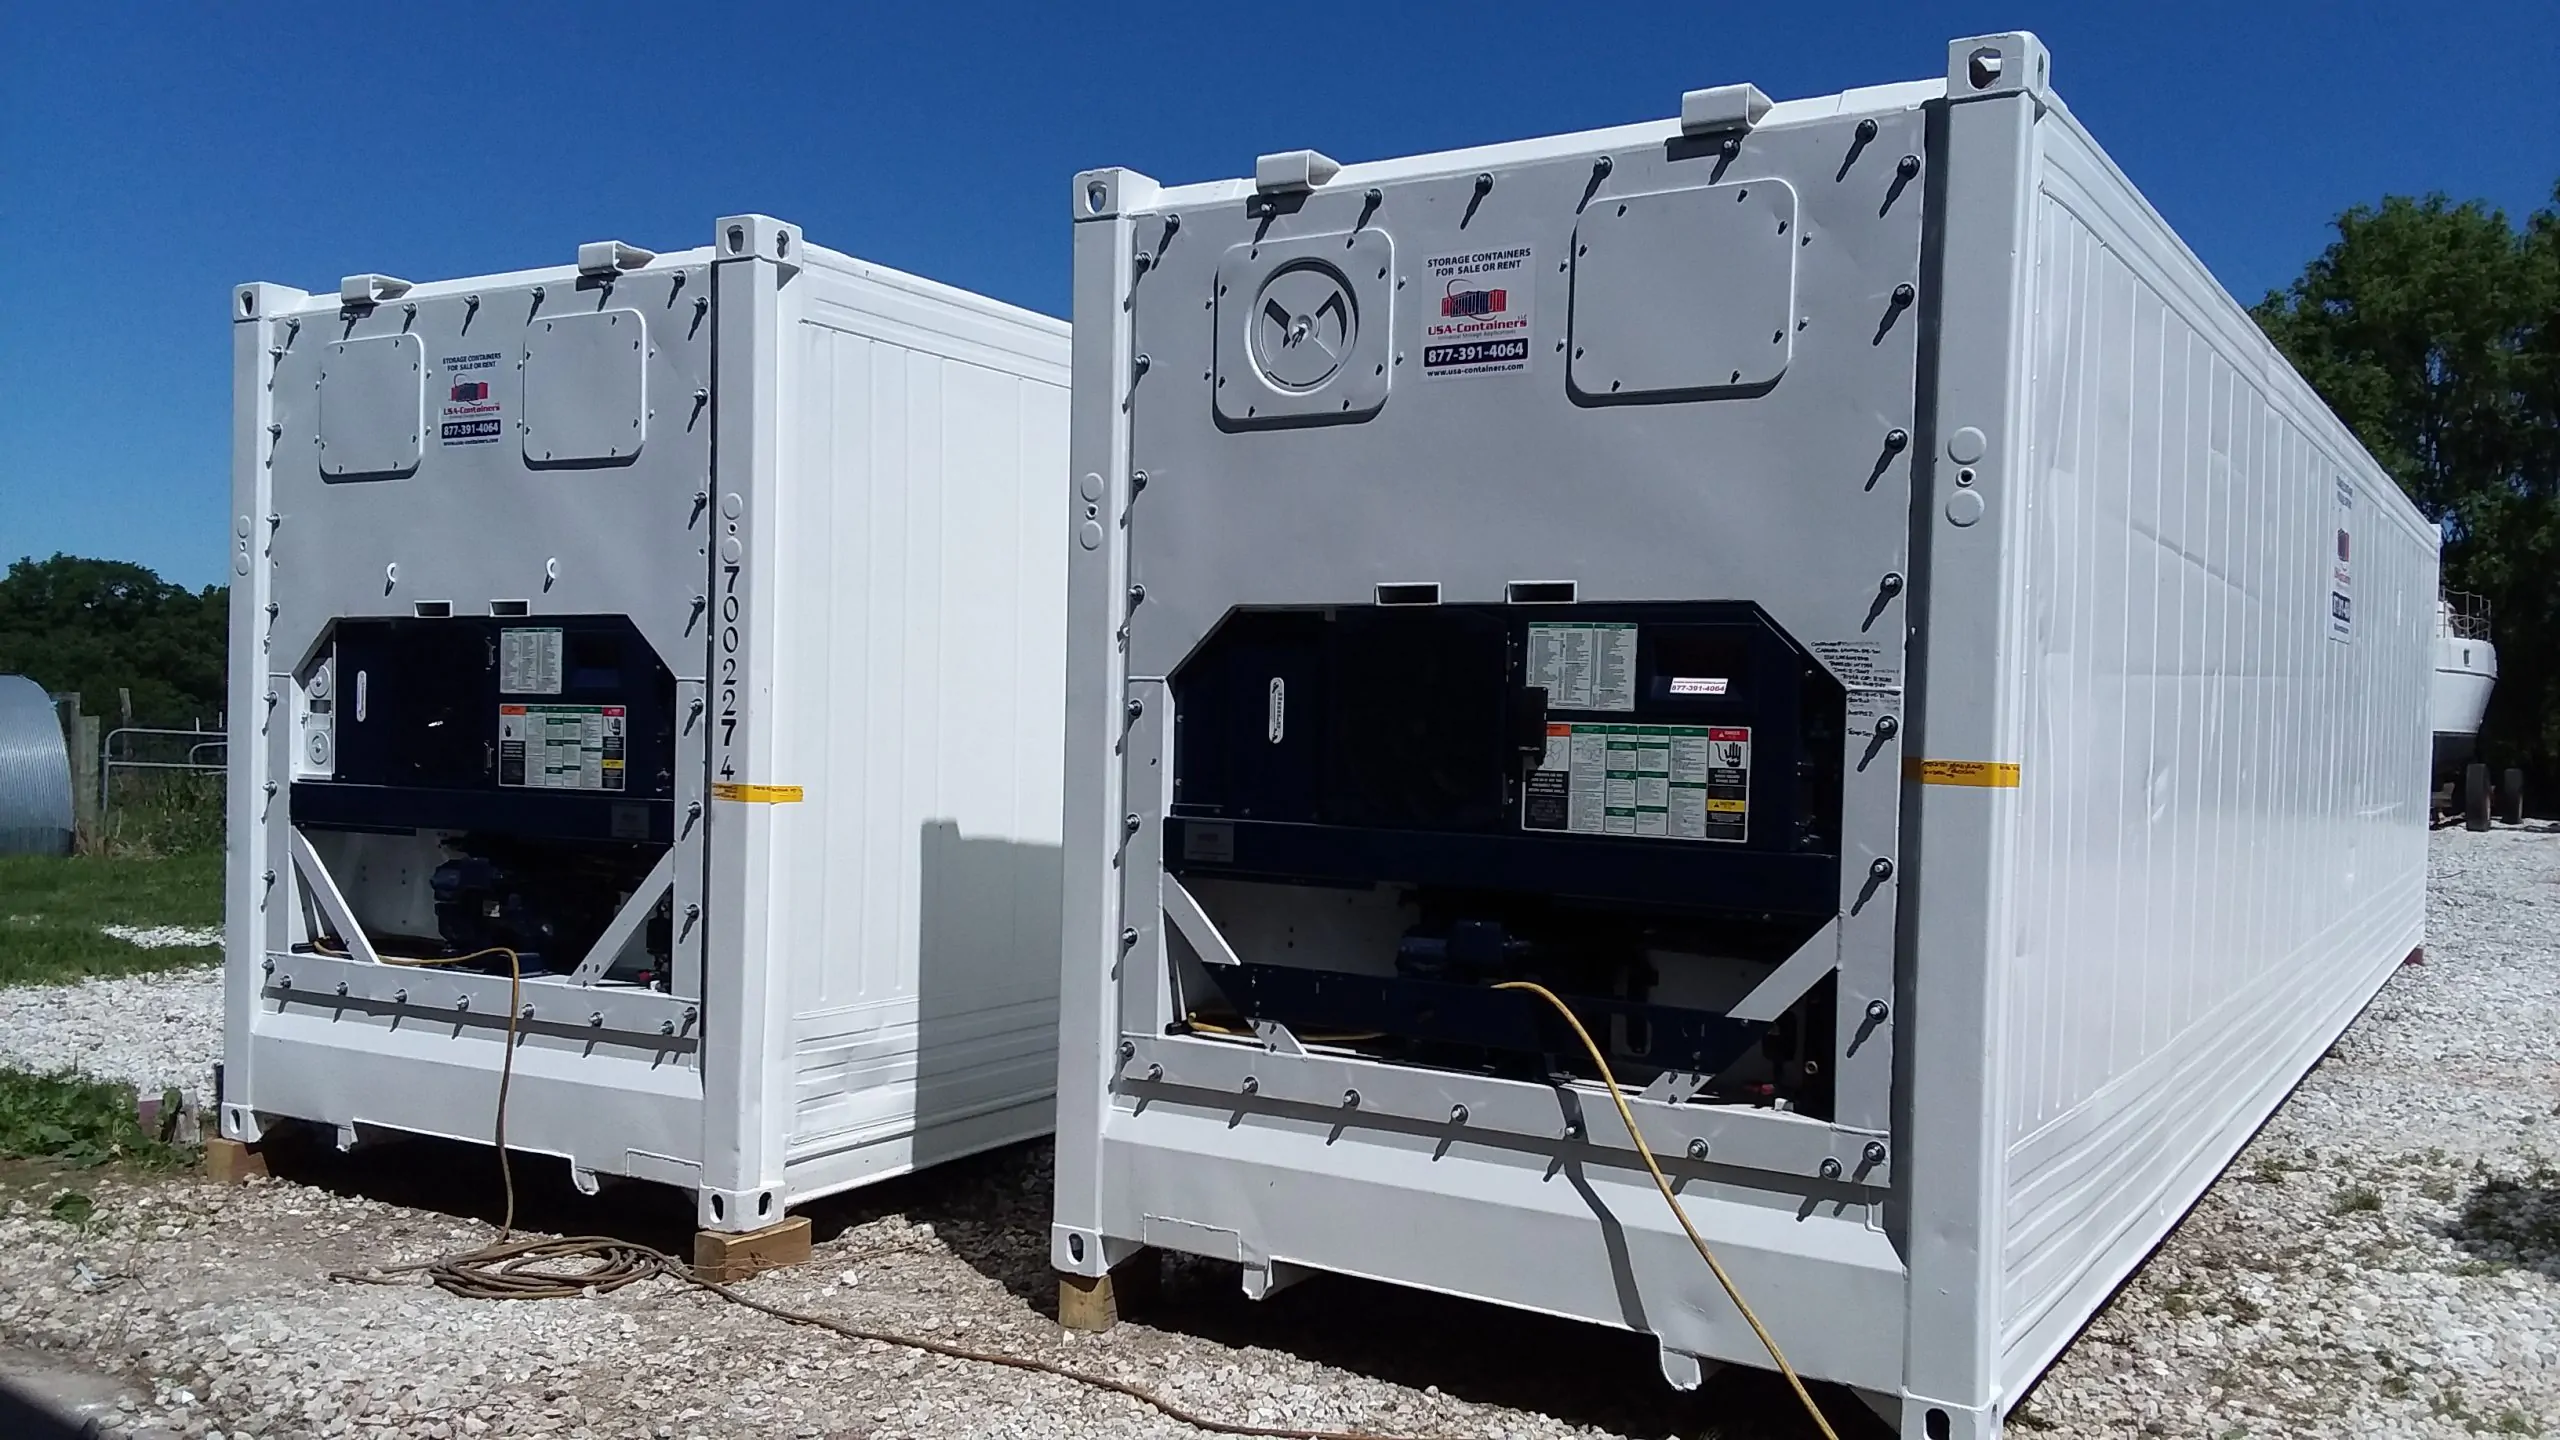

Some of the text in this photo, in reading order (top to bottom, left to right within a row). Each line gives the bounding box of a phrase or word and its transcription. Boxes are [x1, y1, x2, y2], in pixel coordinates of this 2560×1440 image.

[1427, 247, 1531, 268] STORAGE CONTAINERS
[1435, 259, 1522, 277] FOR SALE OR RENT
[1428, 319, 1527, 336] USA-Containers
[442, 352, 502, 364] STORAGE CONTAINERS
[1428, 342, 1524, 363] 877-391-4064
[482, 360, 496, 368] RENT
[1427, 363, 1524, 377] www.usa-containers.com
[443, 422, 499, 436] 877-391-4064
[720, 565, 740, 782] 7002274
[1671, 684, 1725, 692] 877-391-4064
